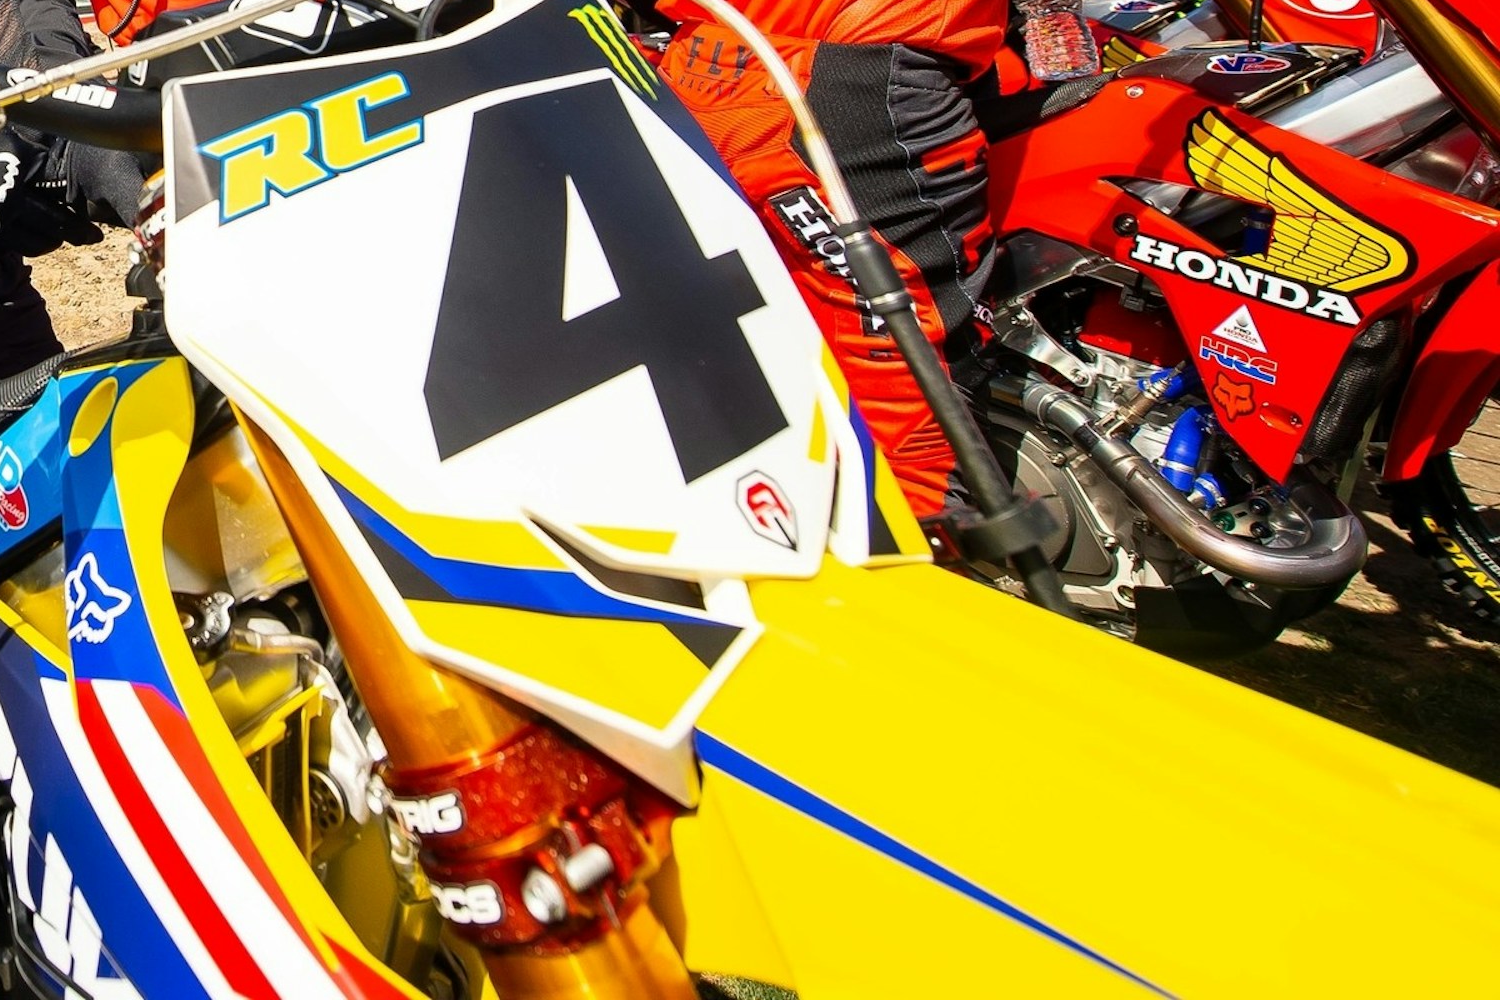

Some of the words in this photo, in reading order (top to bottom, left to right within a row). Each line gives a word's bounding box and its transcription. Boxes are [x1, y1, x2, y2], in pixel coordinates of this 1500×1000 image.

[198, 70, 426, 226] RC
[424, 77, 792, 486] 4
[1131, 234, 1362, 327] HONDA
[1199, 335, 1279, 386] HRC
